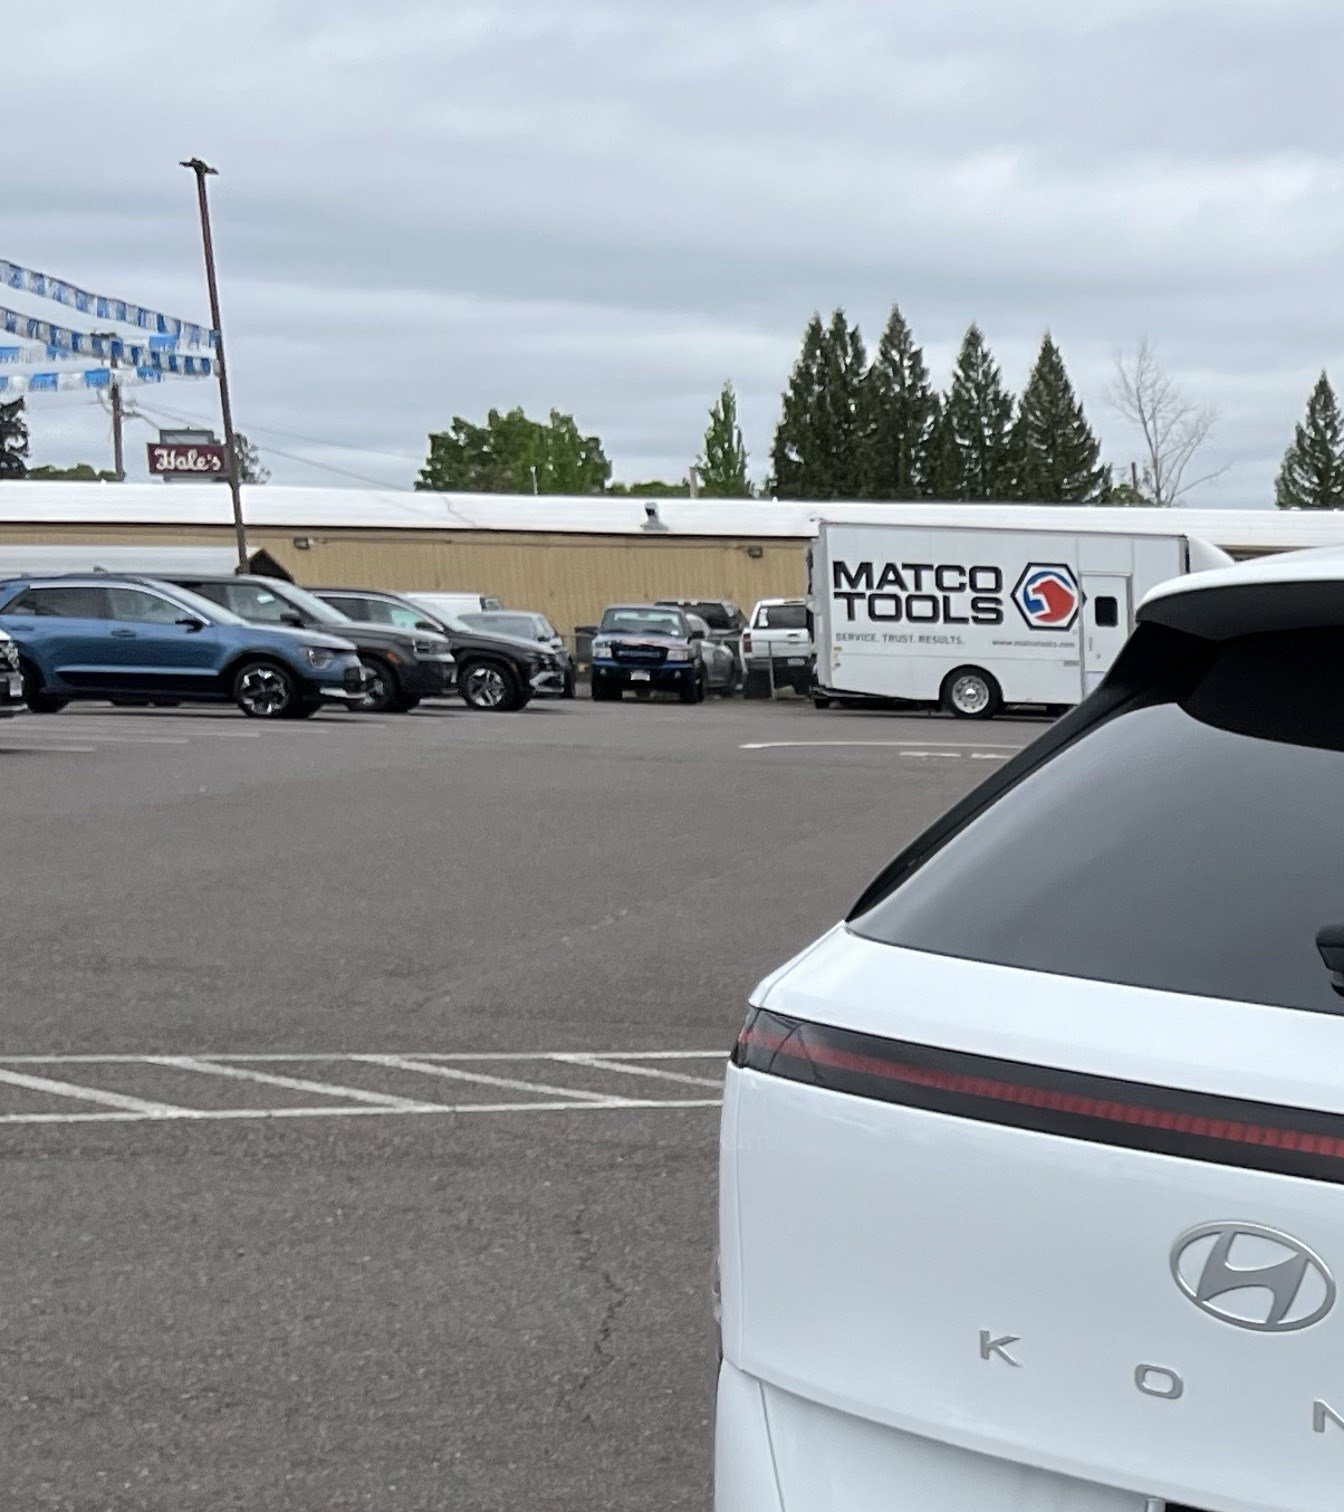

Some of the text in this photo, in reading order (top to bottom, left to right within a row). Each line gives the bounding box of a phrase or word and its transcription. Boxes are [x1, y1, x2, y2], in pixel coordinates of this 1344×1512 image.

[154, 448, 221, 471] Hale's
[832, 560, 1003, 594] MATCO
[833, 592, 1004, 625] TOOLS
